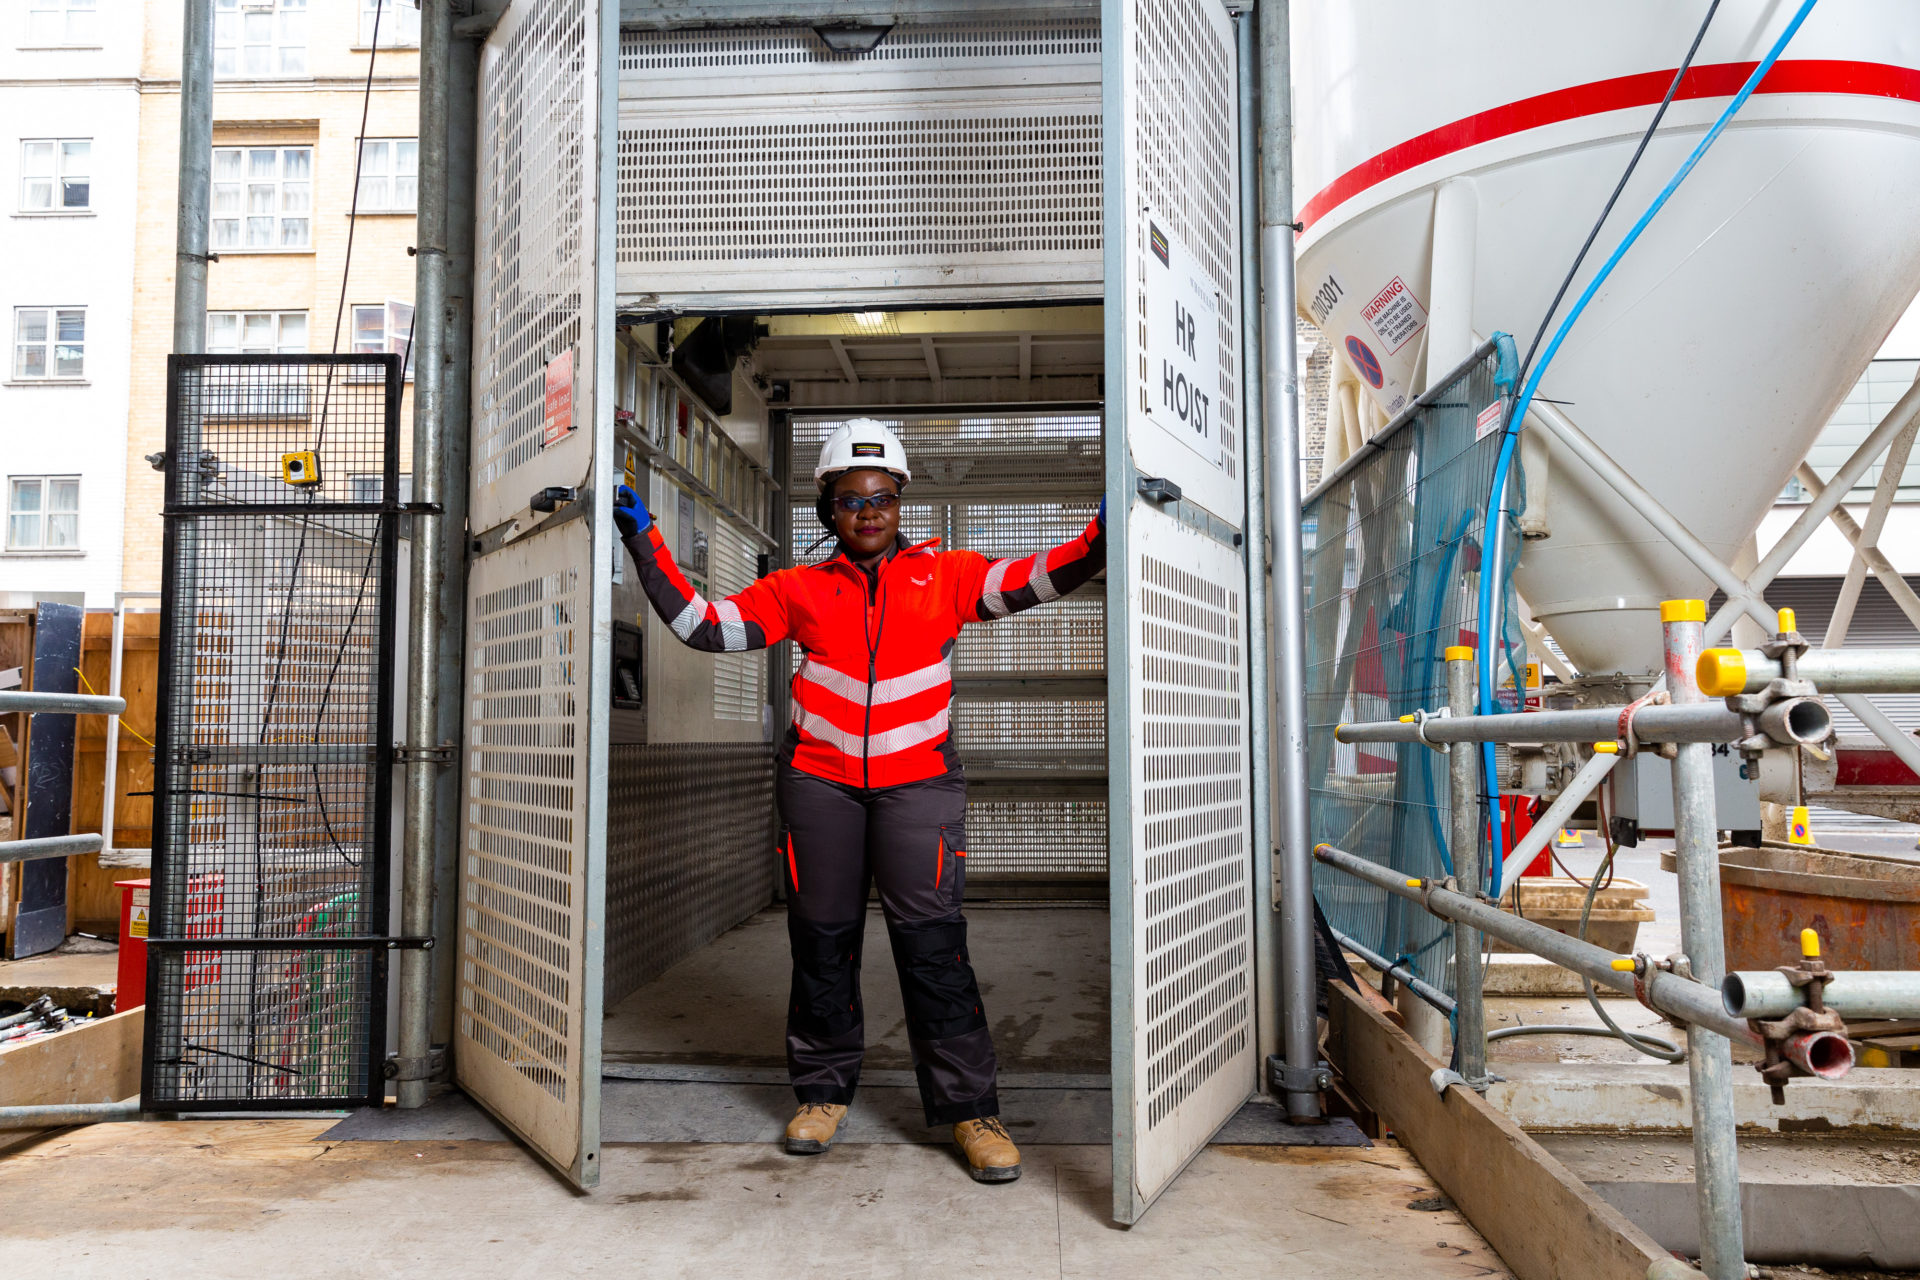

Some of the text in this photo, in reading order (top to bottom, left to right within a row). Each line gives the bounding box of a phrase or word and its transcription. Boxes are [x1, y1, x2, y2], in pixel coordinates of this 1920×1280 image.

[1363, 281, 1403, 321] WARNING
[1374, 316, 1384, 327] THIS
[1382, 300, 1401, 319] MACHINE
[1175, 299, 1196, 362] HR
[1378, 302, 1412, 336] ONLY TO BE USED
[1387, 313, 1412, 338] BY TRAINED
[1391, 320, 1418, 344] OPERATORS
[547, 392, 570, 413] safe load
[1163, 358, 1209, 438] HOIST
